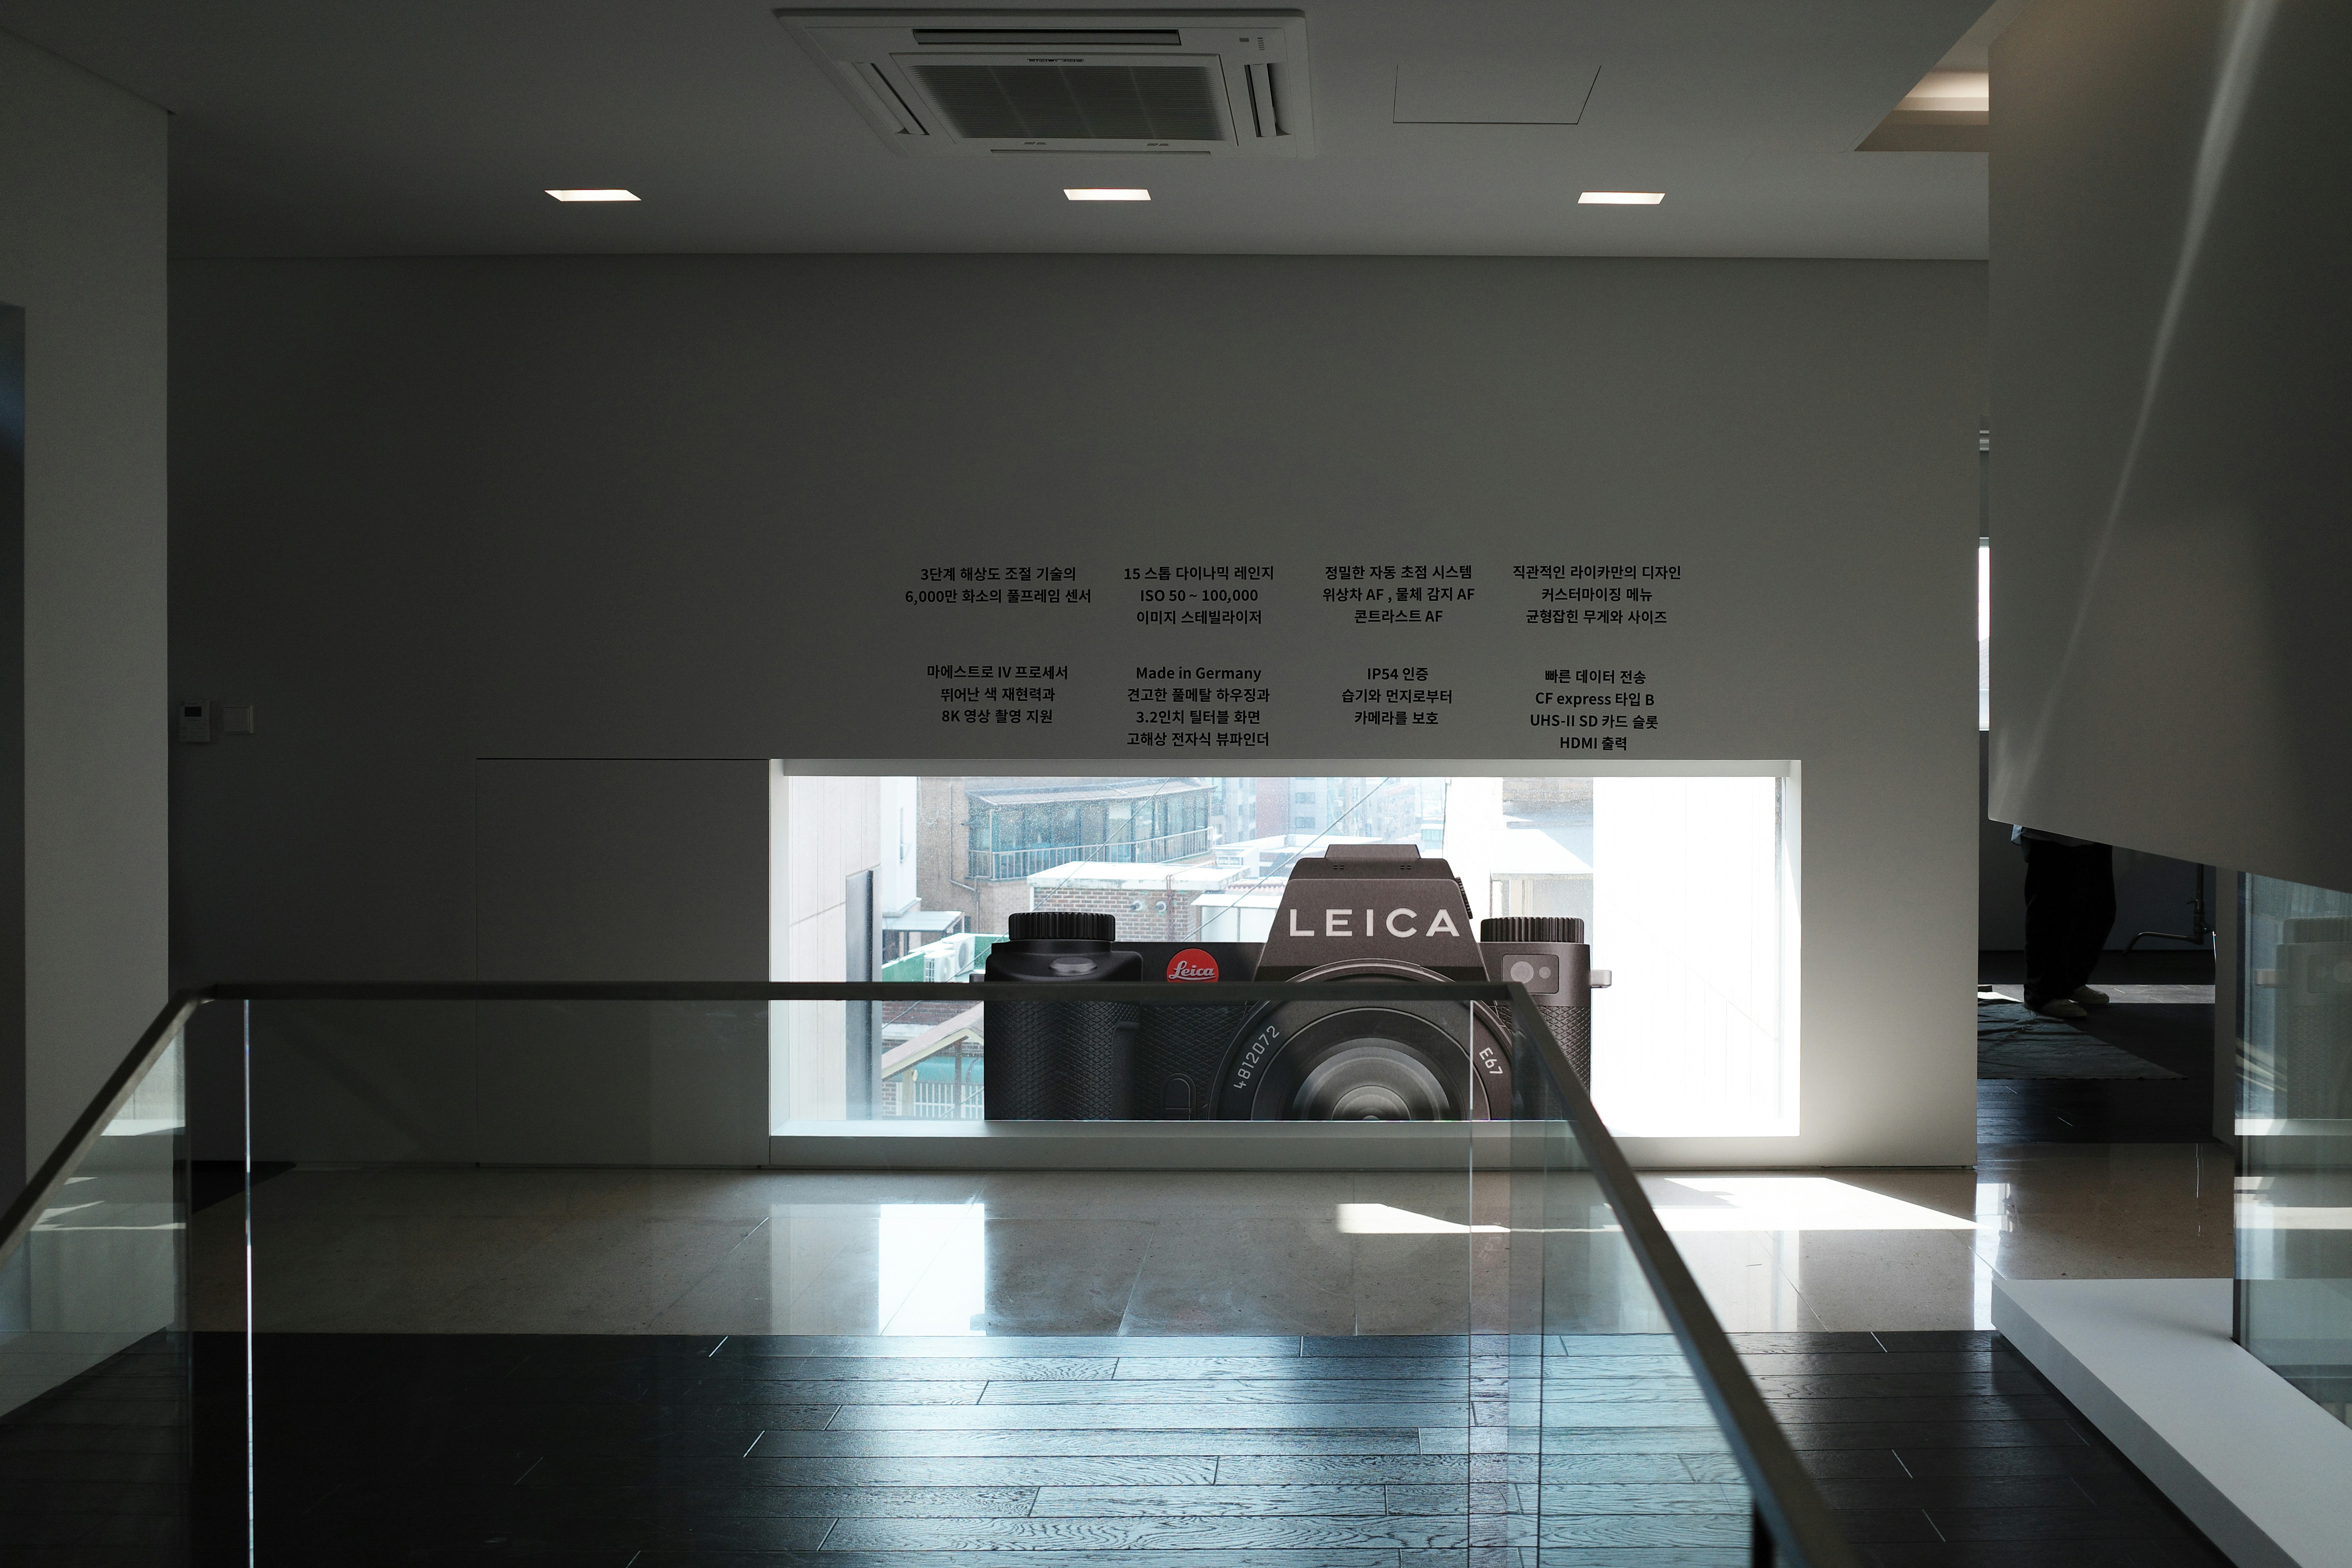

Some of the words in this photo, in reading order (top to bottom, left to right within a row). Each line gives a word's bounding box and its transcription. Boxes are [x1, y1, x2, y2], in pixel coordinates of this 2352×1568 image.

[921, 567, 956, 582] 3단계
[960, 567, 1001, 582] 해상도
[1005, 567, 1032, 582] 조절
[1037, 567, 1076, 582] 기술의
[1125, 568, 1141, 580] 15
[1145, 567, 1172, 581] 스톱
[1176, 566, 1229, 581] 다이나믹
[1234, 566, 1274, 581] 레인지
[1325, 566, 1366, 581] 정밀한
[1370, 566, 1397, 580] 자동
[1401, 565, 1427, 580] 초점
[1432, 565, 1472, 580] 시스템
[1513, 565, 1566, 580] 직관적인
[1571, 565, 1637, 580] 라이카만의
[1642, 566, 1681, 580] 디자인
[906, 589, 958, 606] 6,000만
[962, 589, 1002, 604] 화소의
[1007, 589, 1060, 604] 풀프레임
[1065, 589, 1091, 604] 센서
[1141, 590, 1165, 602] ISO
[1169, 590, 1186, 602] 50
[1202, 590, 1259, 604] 100,000
[1323, 588, 1363, 603] 위상차
[1366, 589, 1385, 601] AF
[1396, 587, 1422, 602] 물체
[1427, 587, 1453, 602] 감지
[1457, 588, 1475, 601] AF
[1542, 588, 1621, 603] 커스터마이징
[1626, 588, 1653, 603] 메뉴
[1137, 611, 1176, 626] 이미지
[1181, 610, 1262, 625] 스테빌라이저
[1354, 609, 1422, 624] 콘트라스트
[1425, 610, 1443, 622] AF
[1526, 609, 1579, 624] 균형잡힌
[1583, 610, 1624, 624] 무게와
[1628, 610, 1668, 625] 사이즈
[927, 665, 994, 680] 마에스트로
[998, 667, 1012, 679] IV
[1015, 666, 1068, 681] 프로세서
[1137, 666, 1175, 680] Made
[1179, 666, 1192, 679] in
[1196, 667, 1262, 683] Germany
[1368, 668, 1399, 681] IP54
[1403, 667, 1429, 682] 인증
[1545, 669, 1572, 684] 빠른
[1576, 670, 1615, 685] 데이터
[1620, 670, 1647, 685] 전송
[941, 687, 980, 702] 뛰어난
[984, 687, 997, 702] 색
[1002, 687, 1056, 702] 재현력과
[1128, 688, 1168, 702] 견고한
[1172, 688, 1212, 703] 풀메탈
[1216, 688, 1270, 703] 하우징과
[1342, 689, 1382, 704] 습기와
[1387, 689, 1452, 704] 먼지로부터
[1535, 692, 1554, 705] CF
[1557, 695, 1612, 708] express
[1615, 692, 1641, 707] 타입
[1646, 694, 1655, 706] B
[942, 710, 961, 722] 8K
[964, 709, 991, 724] 영상
[996, 709, 1021, 724] 촬영
[1027, 710, 1053, 724] 지원
[1136, 710, 1184, 725] 3.2인치
[1190, 710, 1230, 725] 틸터블
[1234, 710, 1260, 725] 화면
[1355, 711, 1408, 726] 카메라를
[1412, 711, 1439, 725] 보호
[1531, 714, 1575, 727] UHS-II
[1579, 715, 1599, 728] SD
[1602, 715, 1628, 729] 카드
[1632, 715, 1659, 730] 슬롯
[1127, 732, 1168, 747] 고해상
[1172, 732, 1211, 747] 전자식
[1216, 732, 1269, 747] 뷰파인더
[1561, 737, 1598, 750] HDMI
[1602, 736, 1627, 751] 출력
[1290, 908, 1460, 938] LEICA
[1169, 960, 1215, 980] Leica
[1233, 1025, 1280, 1089] 4812072
[1479, 1047, 1503, 1074] E67
